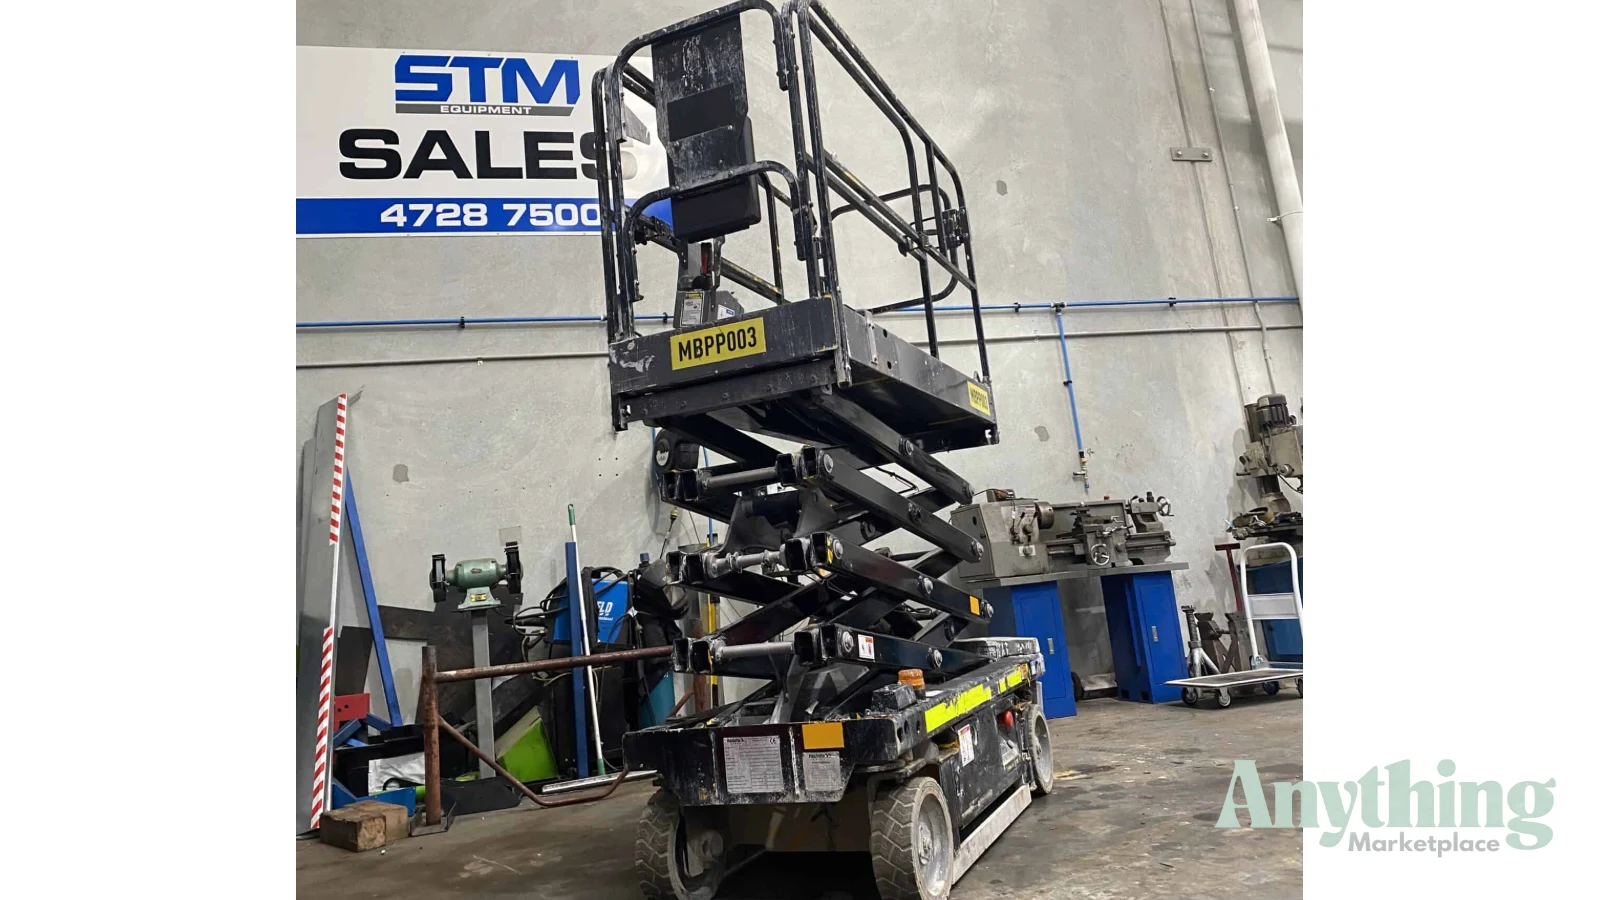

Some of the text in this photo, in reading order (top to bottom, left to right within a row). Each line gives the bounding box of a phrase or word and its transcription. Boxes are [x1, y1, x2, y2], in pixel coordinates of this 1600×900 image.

[394, 55, 581, 105] STM
[440, 104, 532, 115] EQUIPMENT
[380, 203, 602, 227] 4728 7500
[678, 326, 758, 362] MBPP003
